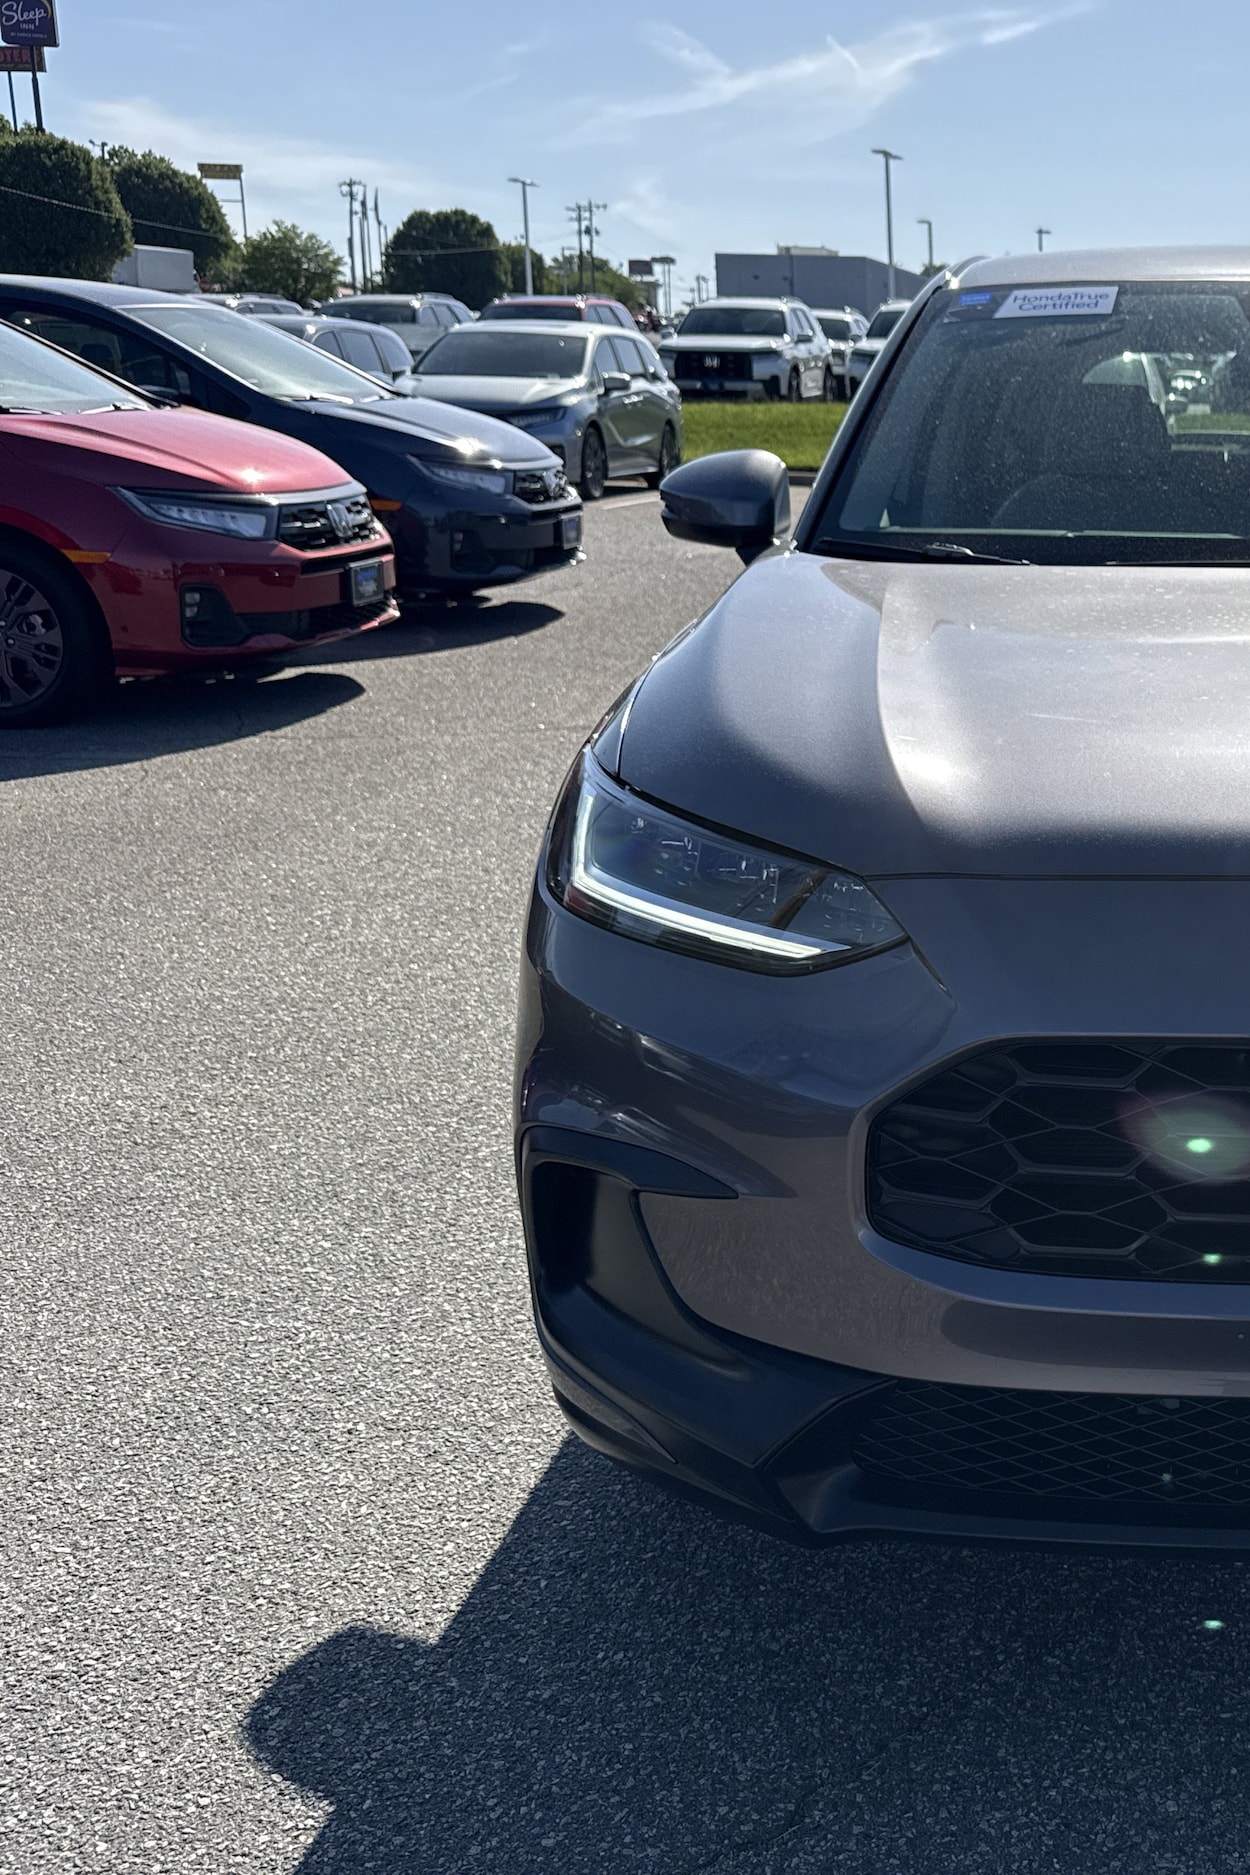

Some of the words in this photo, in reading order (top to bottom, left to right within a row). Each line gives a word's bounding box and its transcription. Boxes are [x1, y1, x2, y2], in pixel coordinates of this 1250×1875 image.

[2, 1, 47, 26] Sleep
[20, 22, 34, 30] INN
[1013, 291, 1110, 304] HondaTrue
[1018, 300, 1099, 312] Certified
